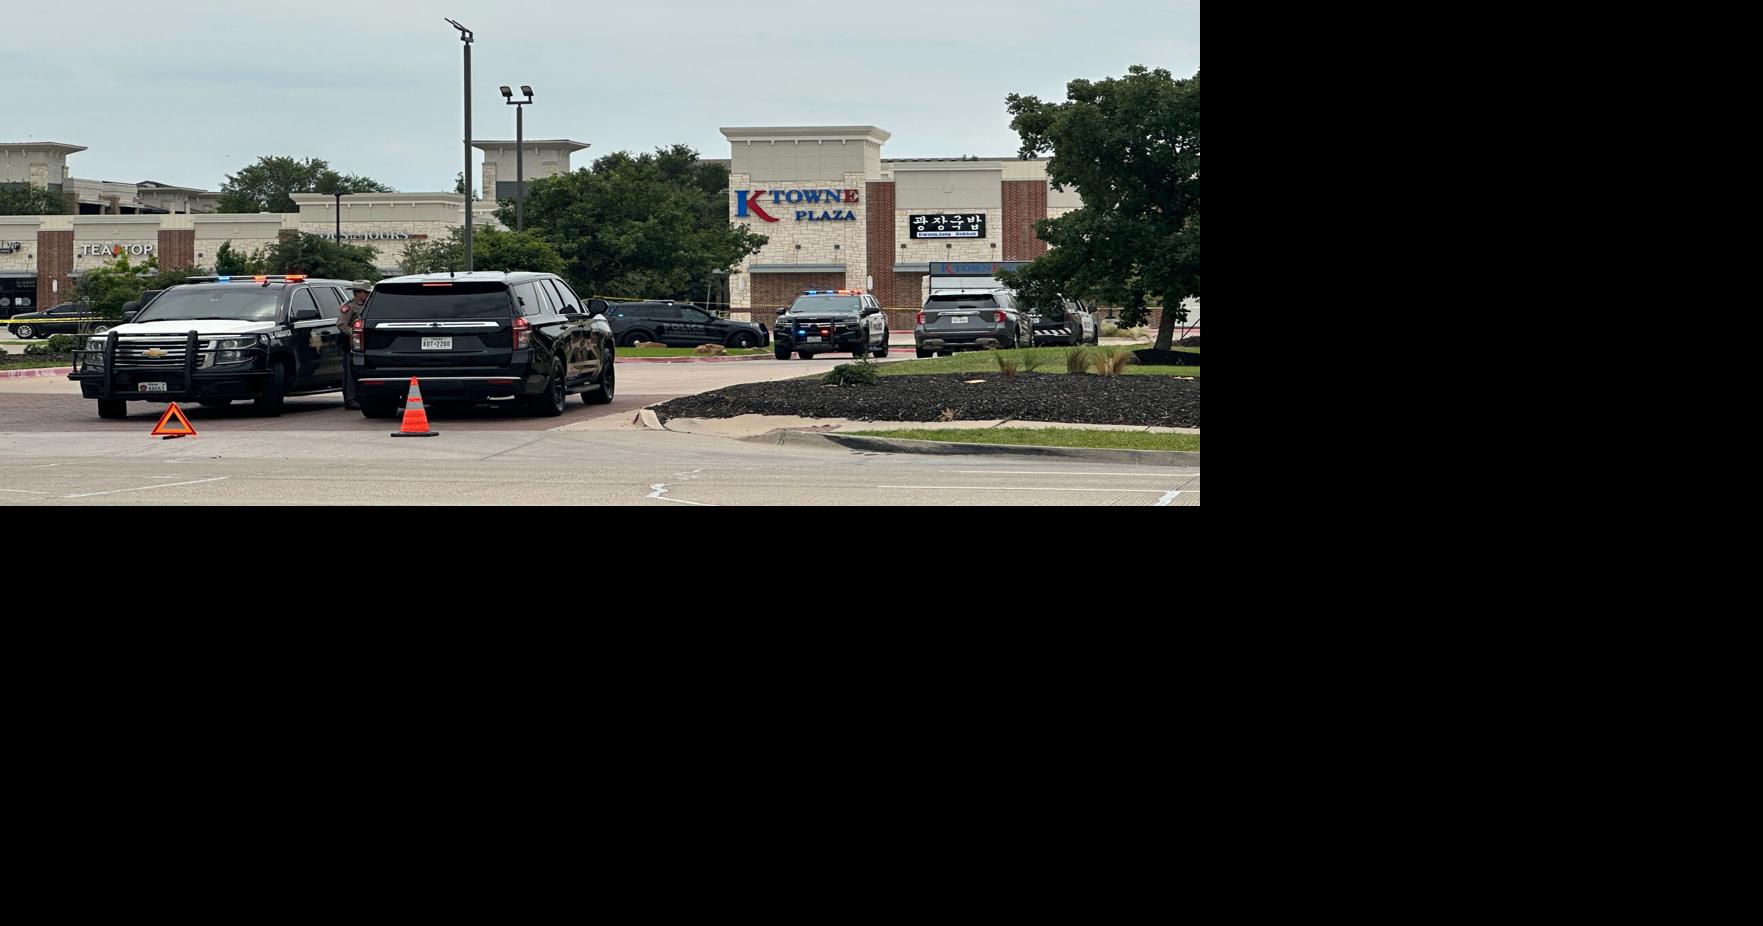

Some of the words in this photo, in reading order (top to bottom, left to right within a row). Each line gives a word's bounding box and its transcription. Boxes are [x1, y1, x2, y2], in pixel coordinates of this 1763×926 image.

[795, 210, 857, 221] PLAZA
[81, 244, 112, 255] TEA
[122, 244, 153, 255] TOP
